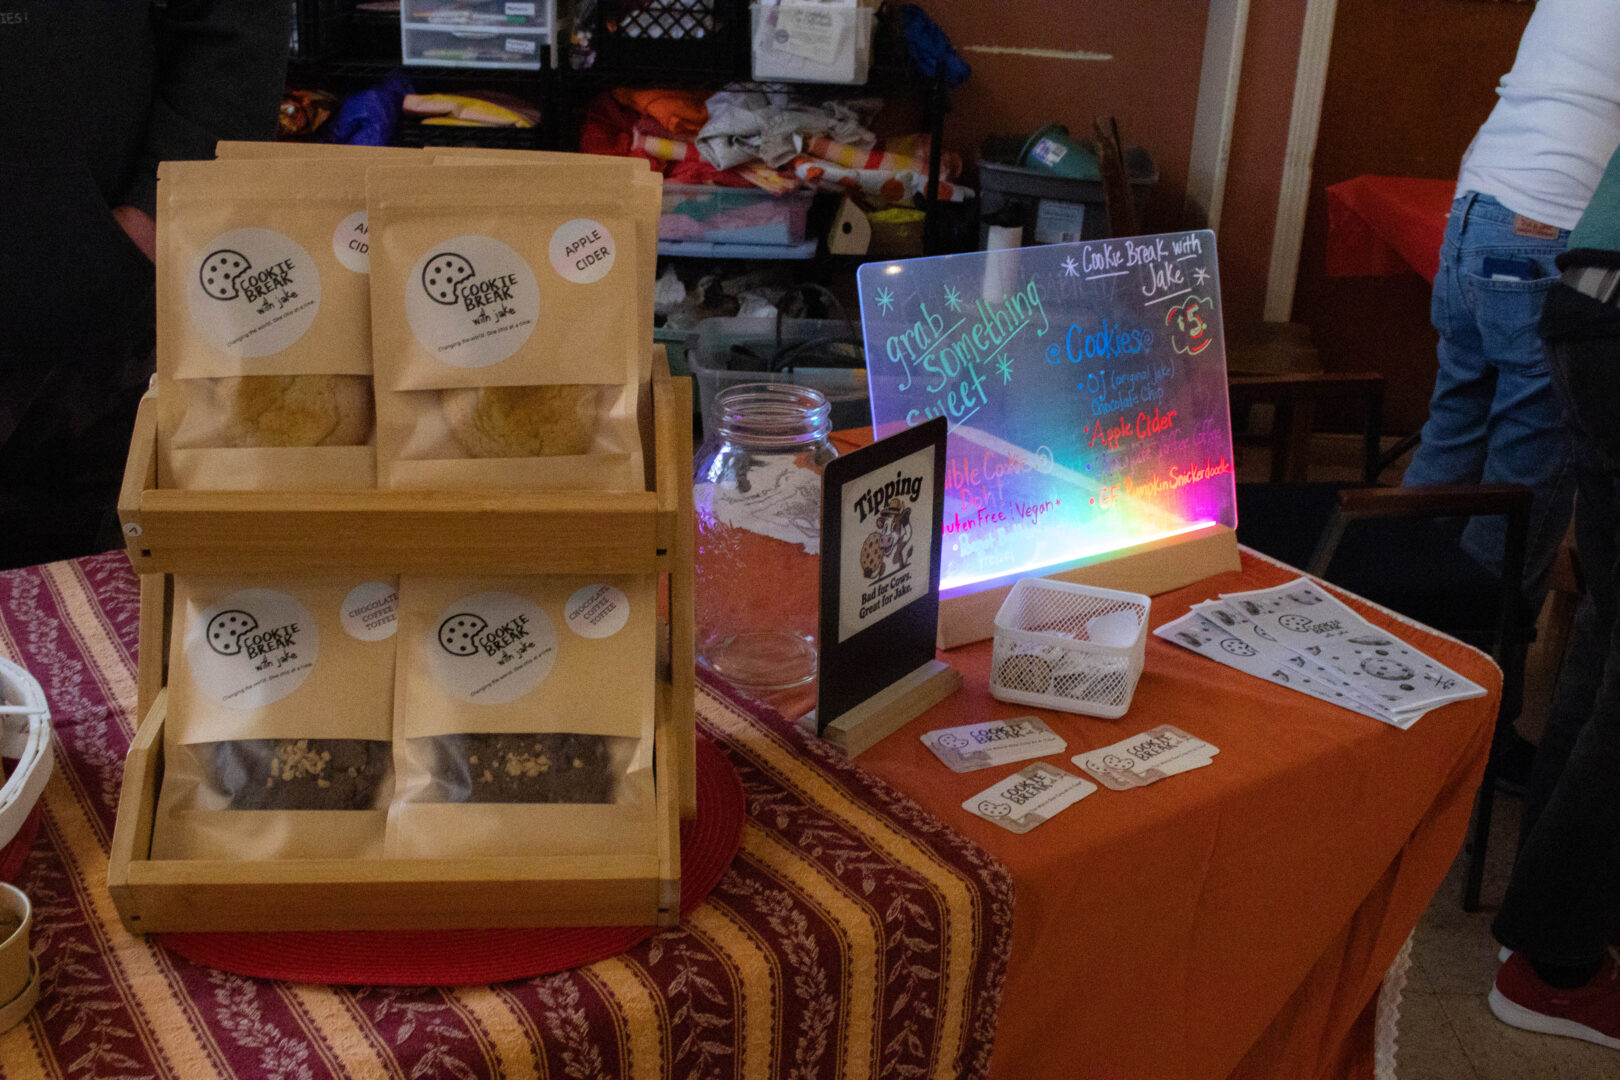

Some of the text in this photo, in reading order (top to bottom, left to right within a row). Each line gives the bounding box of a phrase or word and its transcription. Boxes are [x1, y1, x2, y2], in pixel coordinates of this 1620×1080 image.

[349, 239, 369, 256] CID
[565, 230, 602, 257] APPLE
[1083, 233, 1202, 273] Cookie Break with
[575, 246, 610, 271] CIDER
[240, 258, 295, 291] COOKIE
[244, 271, 294, 304] BREAK
[461, 273, 519, 300] COOKIE
[1142, 262, 1184, 297] Jake
[463, 286, 514, 312] BREAK
[472, 302, 516, 325] with jake
[886, 302, 944, 392] grab
[1066, 318, 1142, 363] Cookies
[1089, 408, 1178, 450] Apple Cider
[854, 471, 924, 524] Tipping
[859, 584, 912, 619] Great for Jake.
[861, 572, 912, 605] Bad for Cows.
[348, 592, 399, 618] CHOCOLATE
[362, 605, 395, 622] COFFEE
[568, 584, 611, 621] CHOCOLATE
[244, 622, 301, 648] COOKIE
[479, 613, 530, 648] COOKIE
[484, 625, 530, 657] BREAK
[247, 634, 296, 660] BREAK
[1127, 734, 1173, 756] COOKIE
[1135, 741, 1179, 762] BREAK
[1001, 773, 1047, 800] COOKIE
[1010, 781, 1054, 806] BREAK
